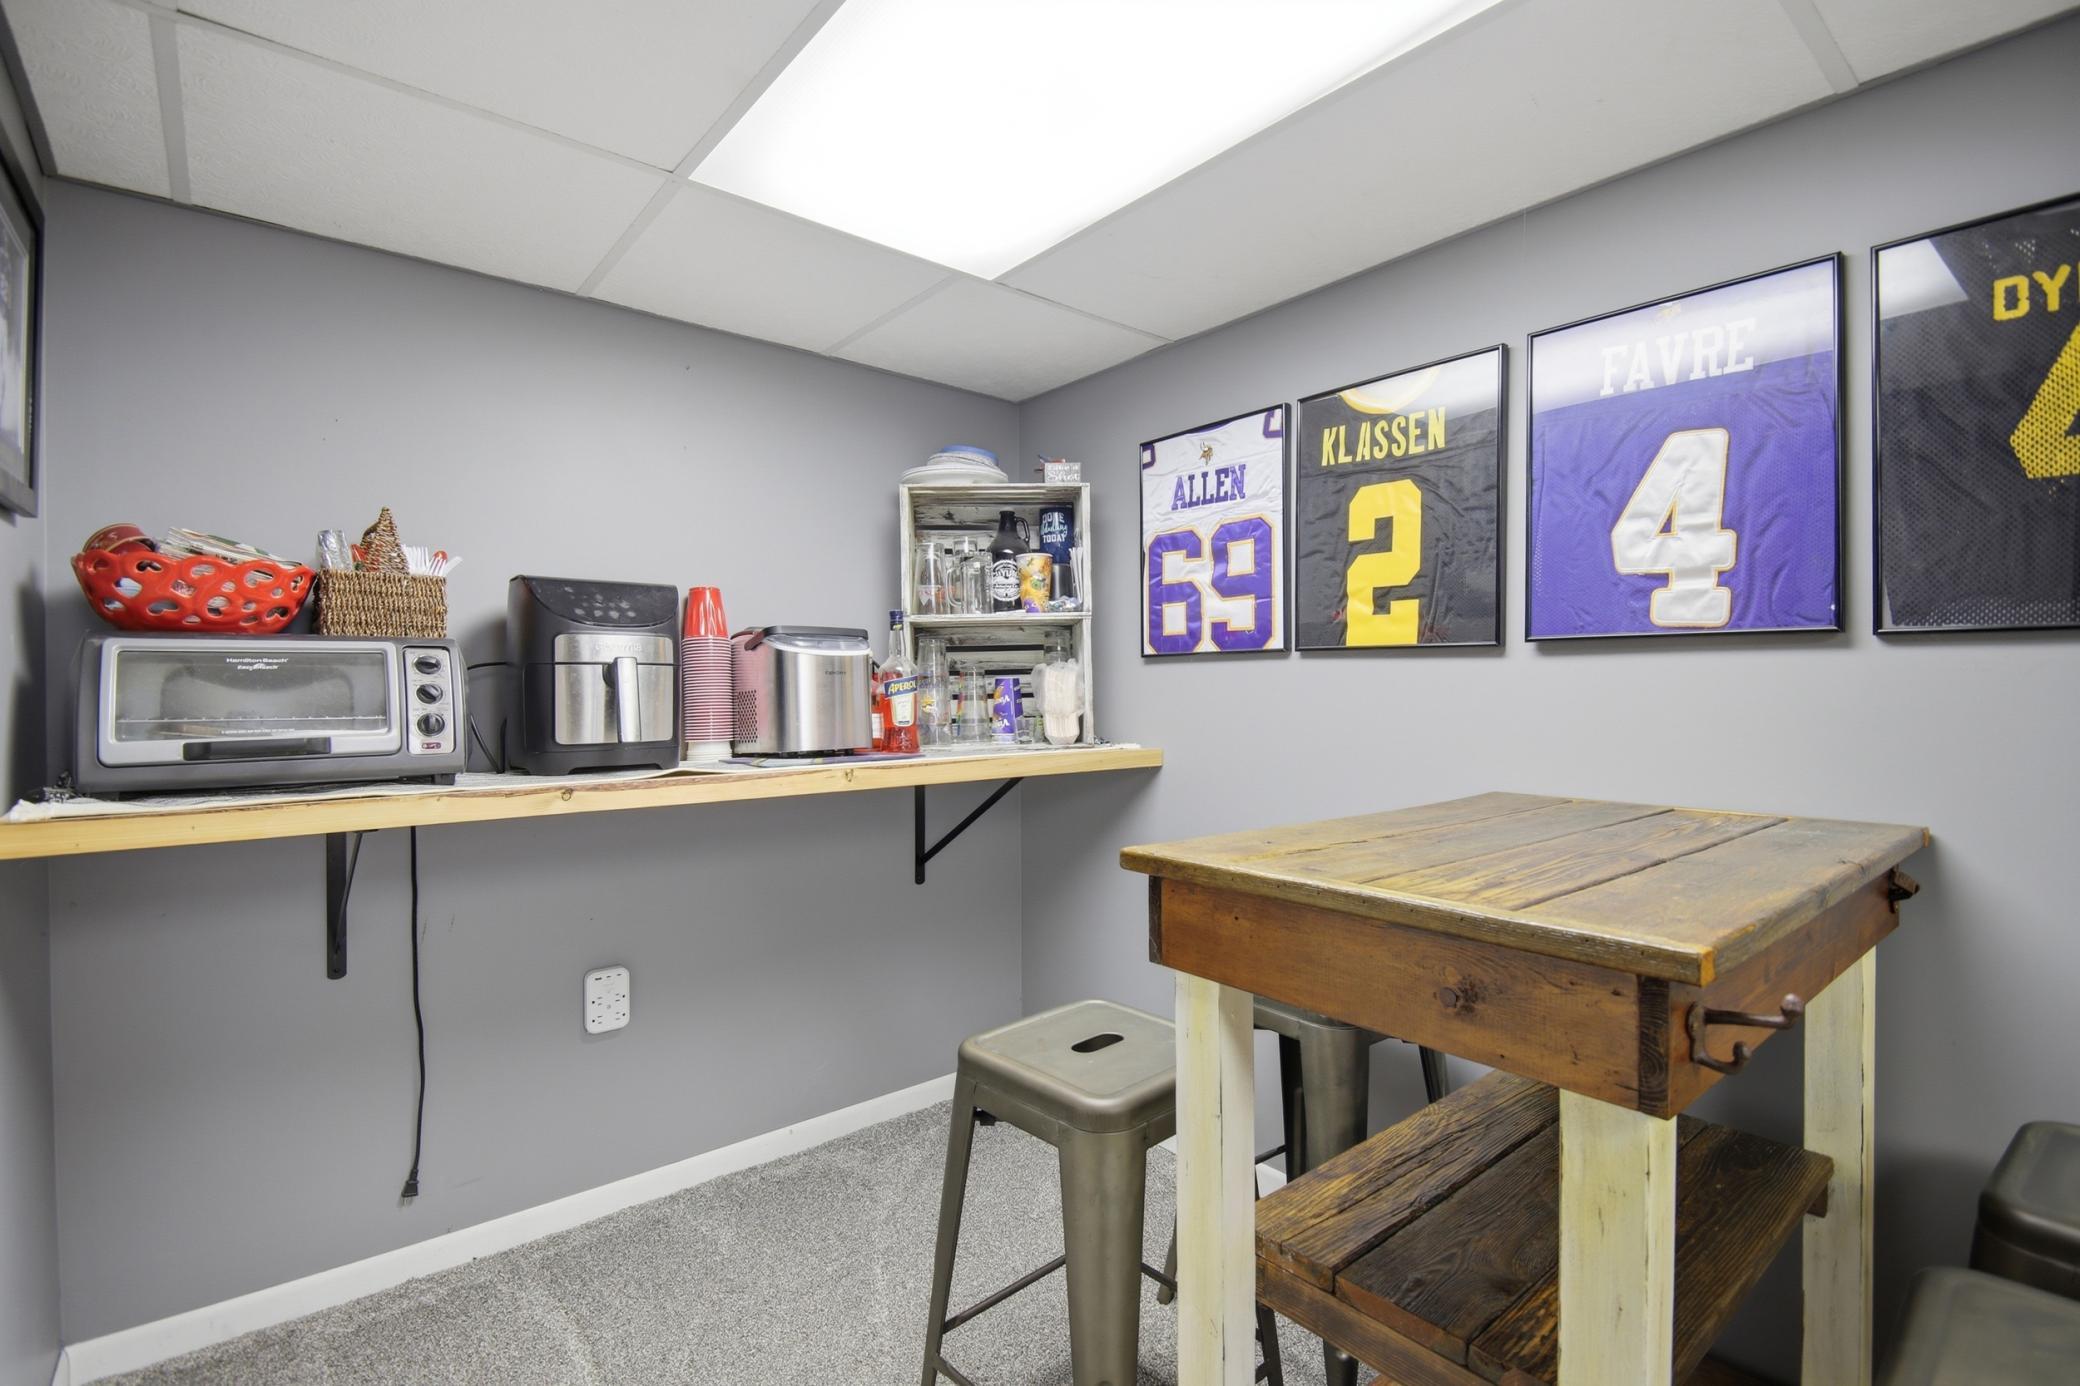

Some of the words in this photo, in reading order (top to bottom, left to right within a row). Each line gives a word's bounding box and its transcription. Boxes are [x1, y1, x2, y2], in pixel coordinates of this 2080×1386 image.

[1993, 262, 2080, 321] DY
[1600, 318, 1756, 397] FAVRE
[1321, 406, 1446, 466] KLASSEN
[1171, 464, 1247, 511] ALLEN
[1042, 534, 1067, 544] TODAY
[1610, 426, 1738, 628] 4
[1145, 512, 1276, 655] 69
[1345, 478, 1422, 647] 2
[887, 680, 917, 696] APEROL
